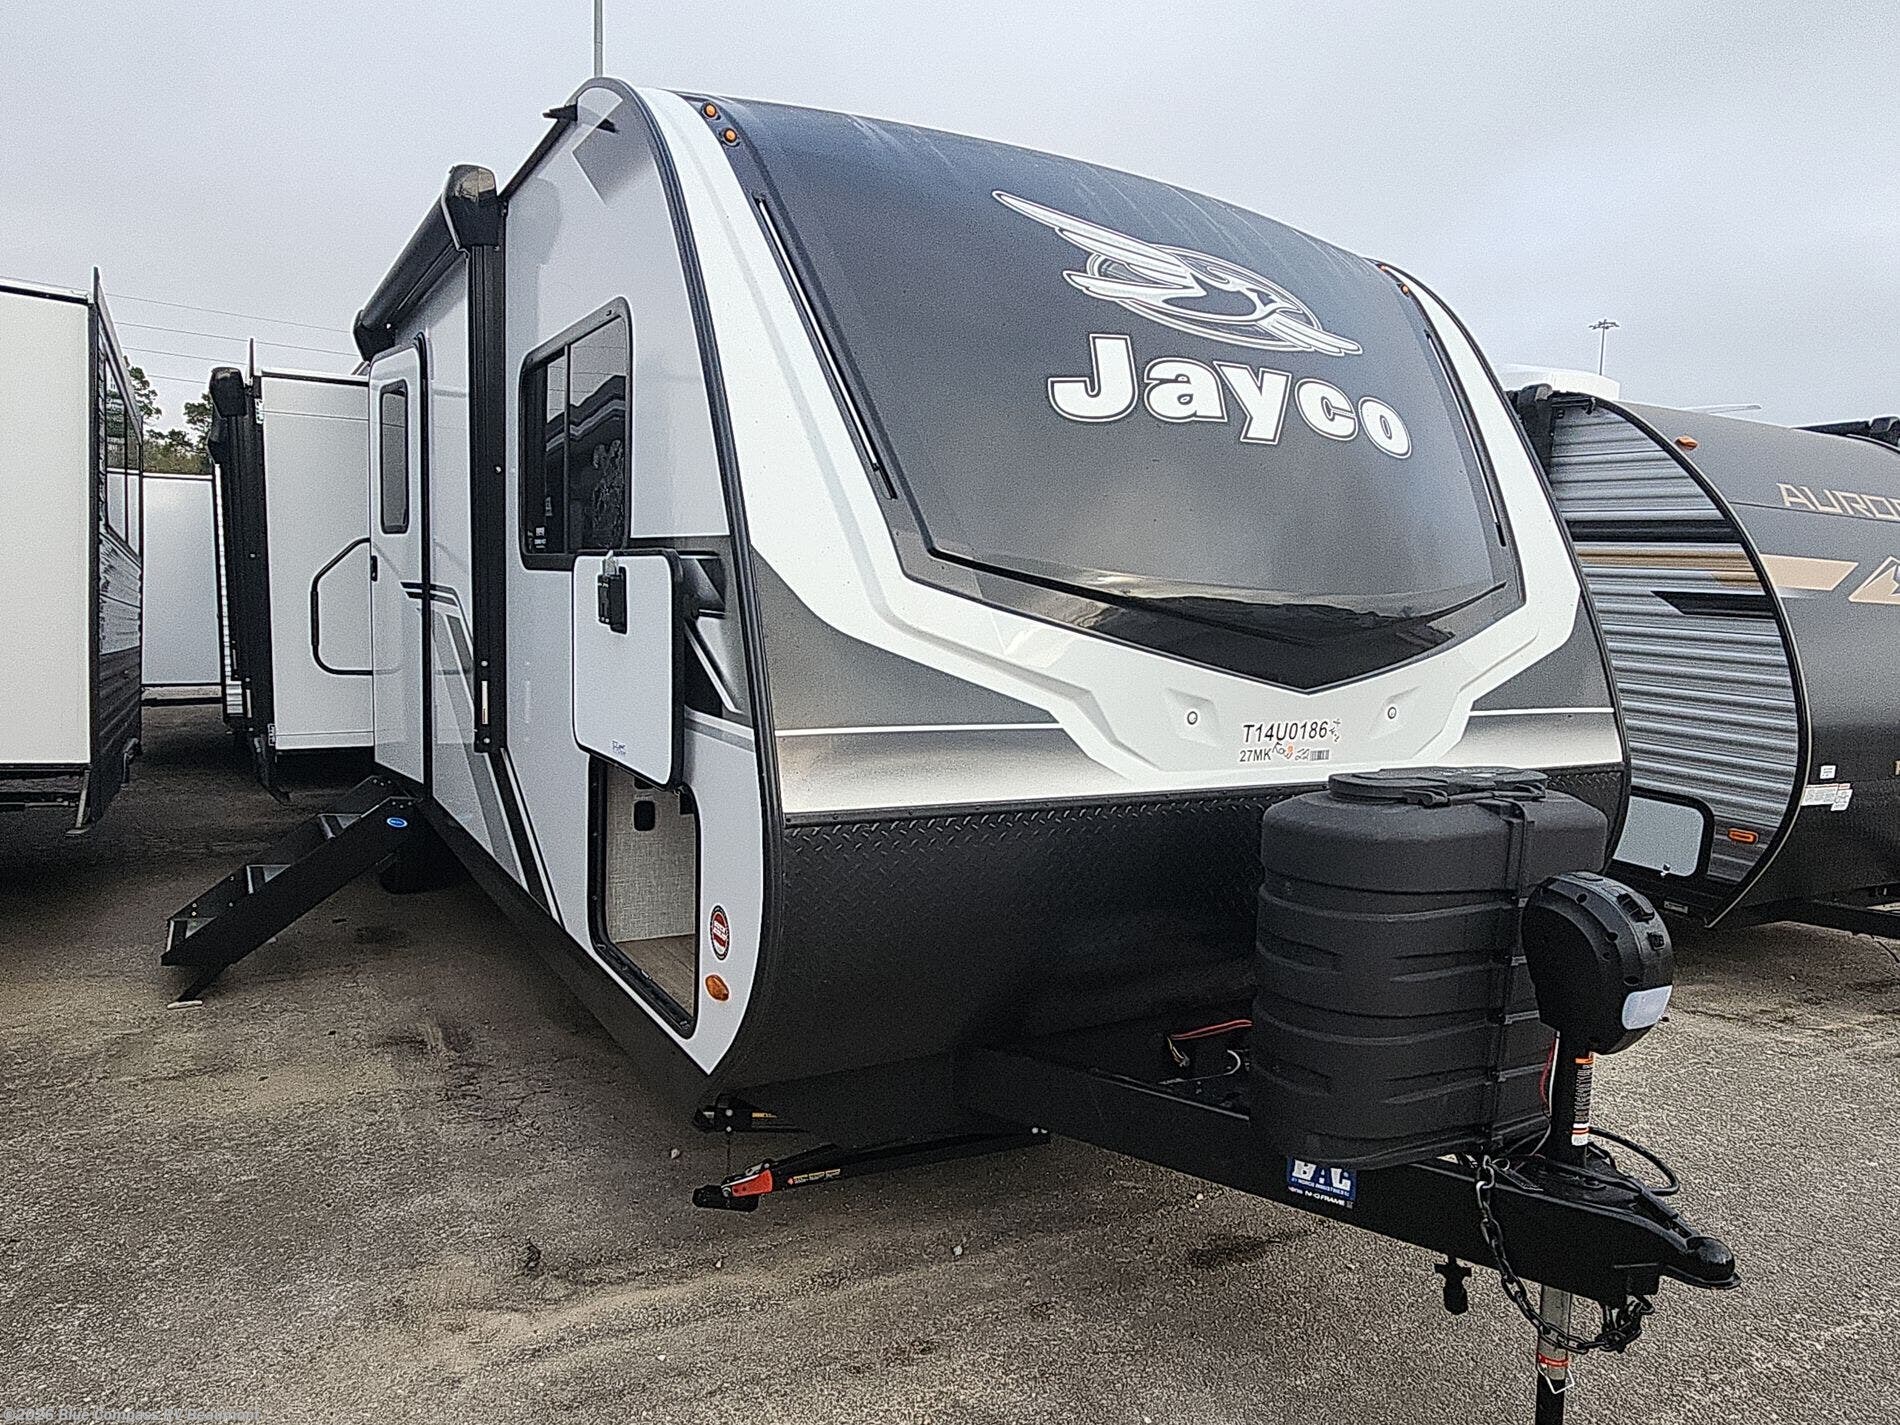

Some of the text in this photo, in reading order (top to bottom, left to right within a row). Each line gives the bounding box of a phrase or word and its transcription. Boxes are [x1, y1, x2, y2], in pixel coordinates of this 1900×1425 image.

[1048, 333, 1411, 459] Jayco
[1776, 482, 1900, 521] AURO
[1243, 720, 1329, 743] T14U0186
[1239, 748, 1271, 762] 27MK
[1320, 1194, 1345, 1207] FRAME
